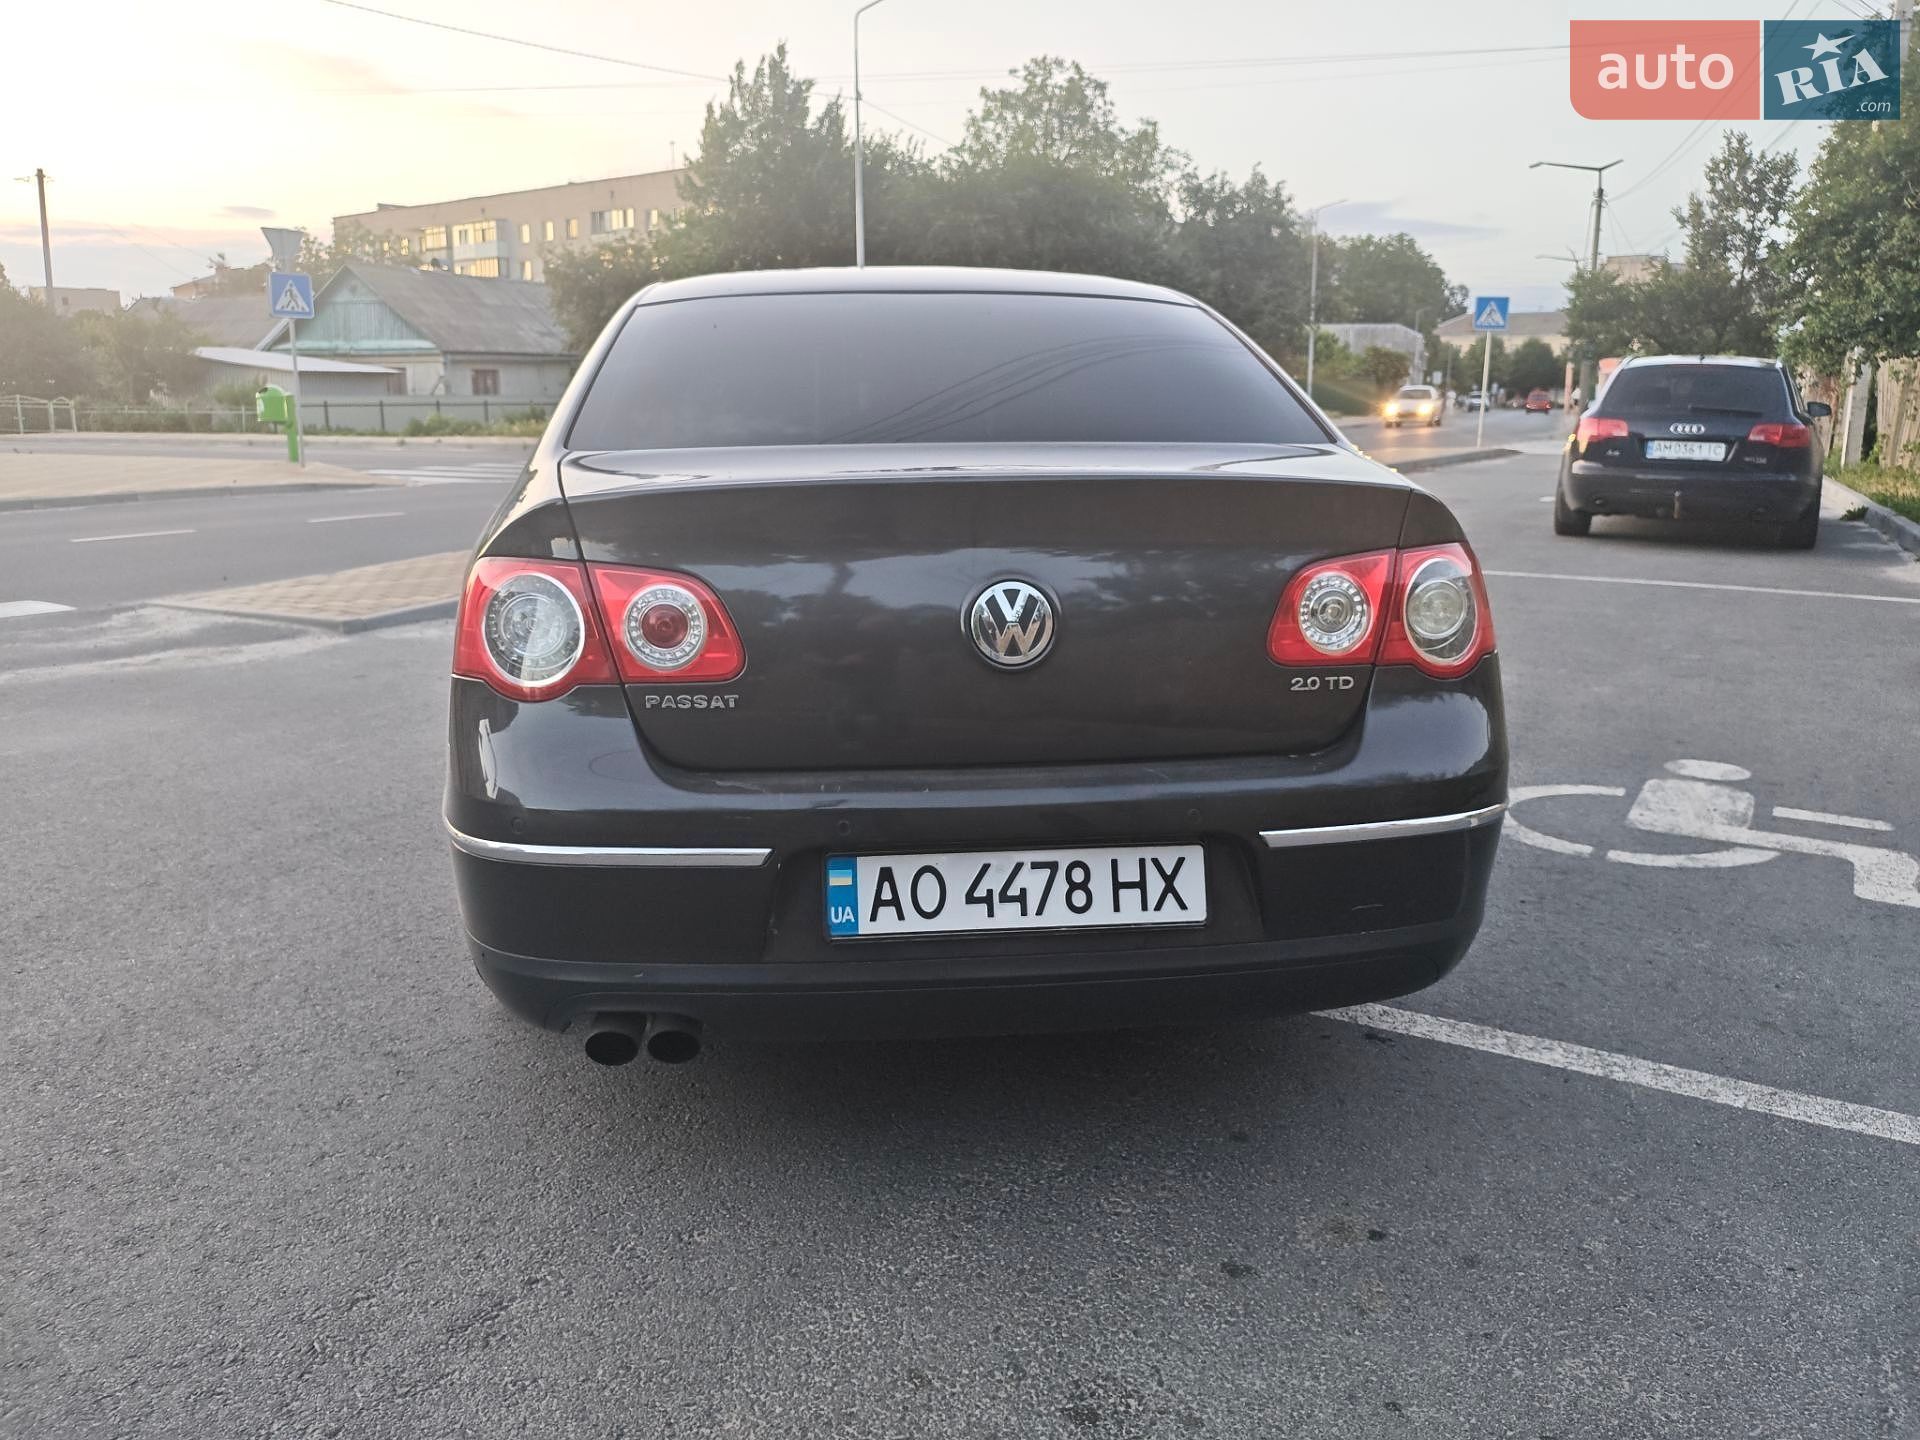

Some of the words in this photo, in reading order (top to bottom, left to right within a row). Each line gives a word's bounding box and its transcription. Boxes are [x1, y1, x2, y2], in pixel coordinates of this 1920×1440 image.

[971, 581, 1053, 665] VW
[1325, 676, 1354, 690] TD
[645, 695, 739, 709] PASSAT
[869, 864, 947, 922] AO
[964, 860, 1093, 918] 4478
[1111, 857, 1189, 913] HX
[831, 906, 855, 924] UA
